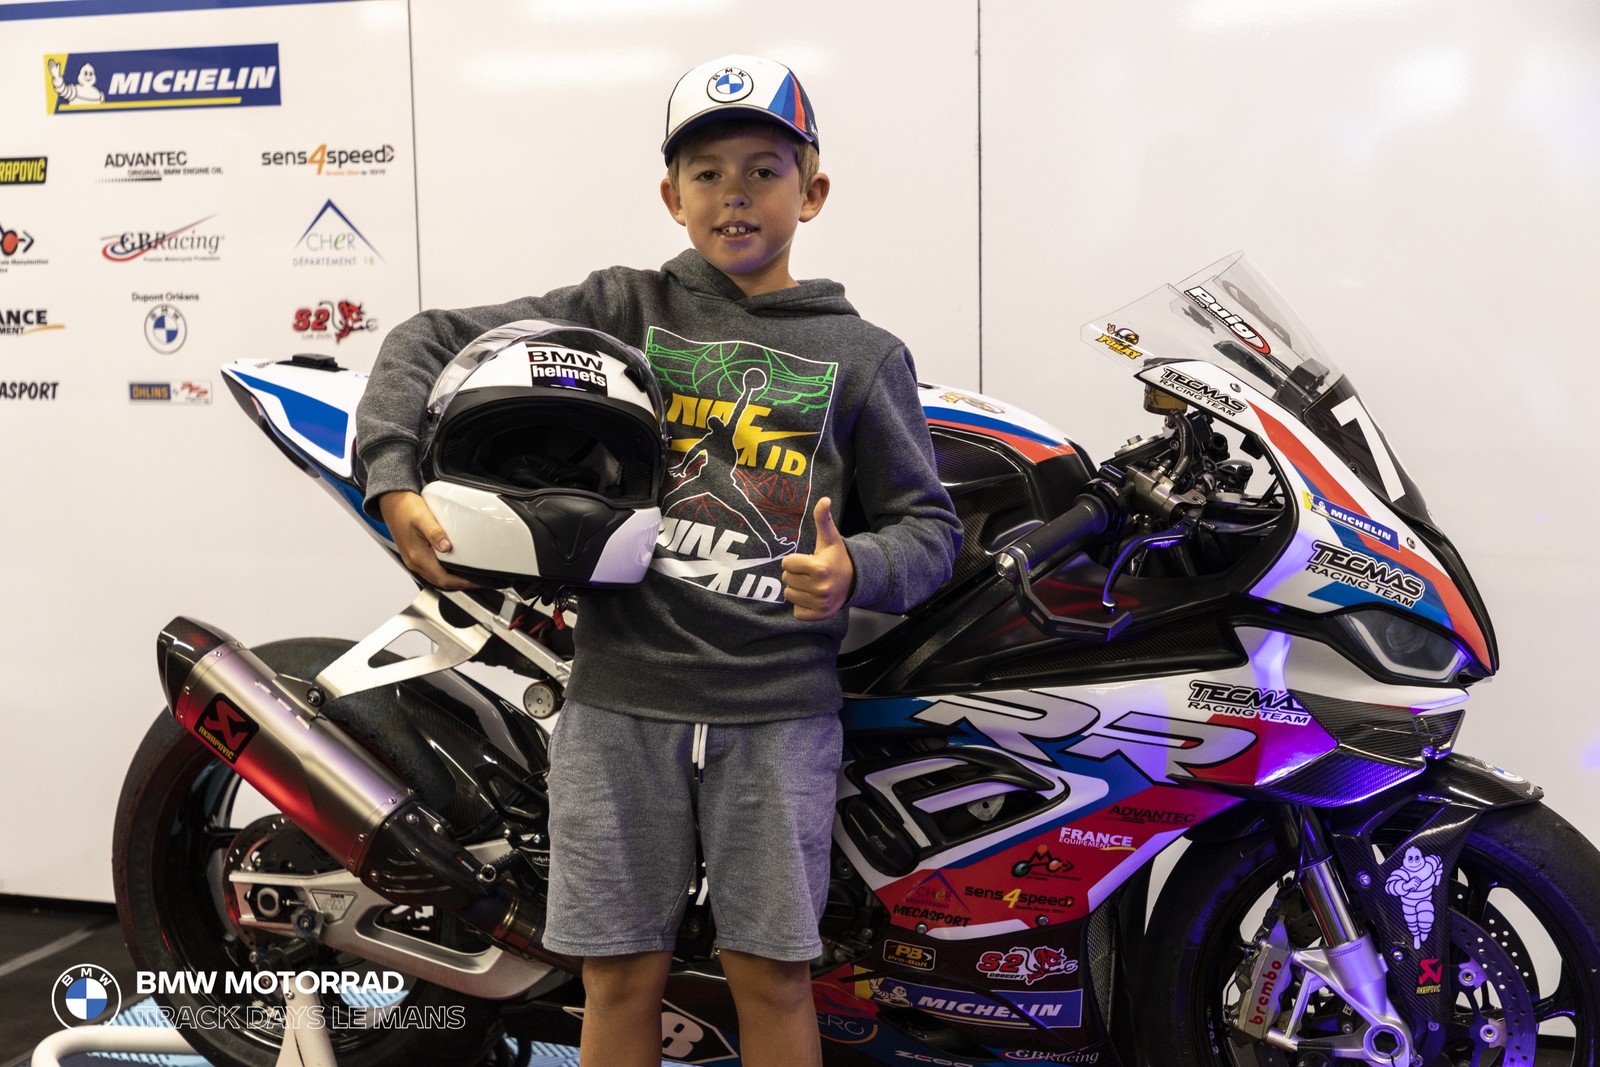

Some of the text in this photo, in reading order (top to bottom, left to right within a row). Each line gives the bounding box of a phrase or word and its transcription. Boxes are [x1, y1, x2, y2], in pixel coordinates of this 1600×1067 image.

[108, 66, 276, 95] MICHELIN
[712, 67, 746, 81] BMW
[104, 151, 187, 167] ADVANTEC
[131, 291, 199, 304] Dupont Orléans
[293, 308, 330, 331] S2
[1187, 286, 1257, 339] Puig
[528, 350, 603, 371] BMW
[532, 365, 606, 387] helmets
[1160, 379, 1236, 417] RACING TEAM
[1161, 366, 1247, 412] TECMAS
[1331, 509, 1391, 541] MICHELIN
[1307, 540, 1425, 599] TECMAS
[1305, 564, 1414, 608] RACING TEAM
[1188, 680, 1311, 715] TECMA
[1188, 701, 1310, 724] RACING TEAM
[1108, 804, 1196, 824] ADVANTEC
[1060, 827, 1133, 847] FRANCE
[893, 904, 971, 927] MECASPORT
[887, 955, 928, 968] Pro-Bolt
[895, 944, 923, 960] PB
[978, 952, 1025, 973] S2
[1249, 960, 1282, 1025] brembo
[1015, 1049, 1099, 1064] GBRacing
